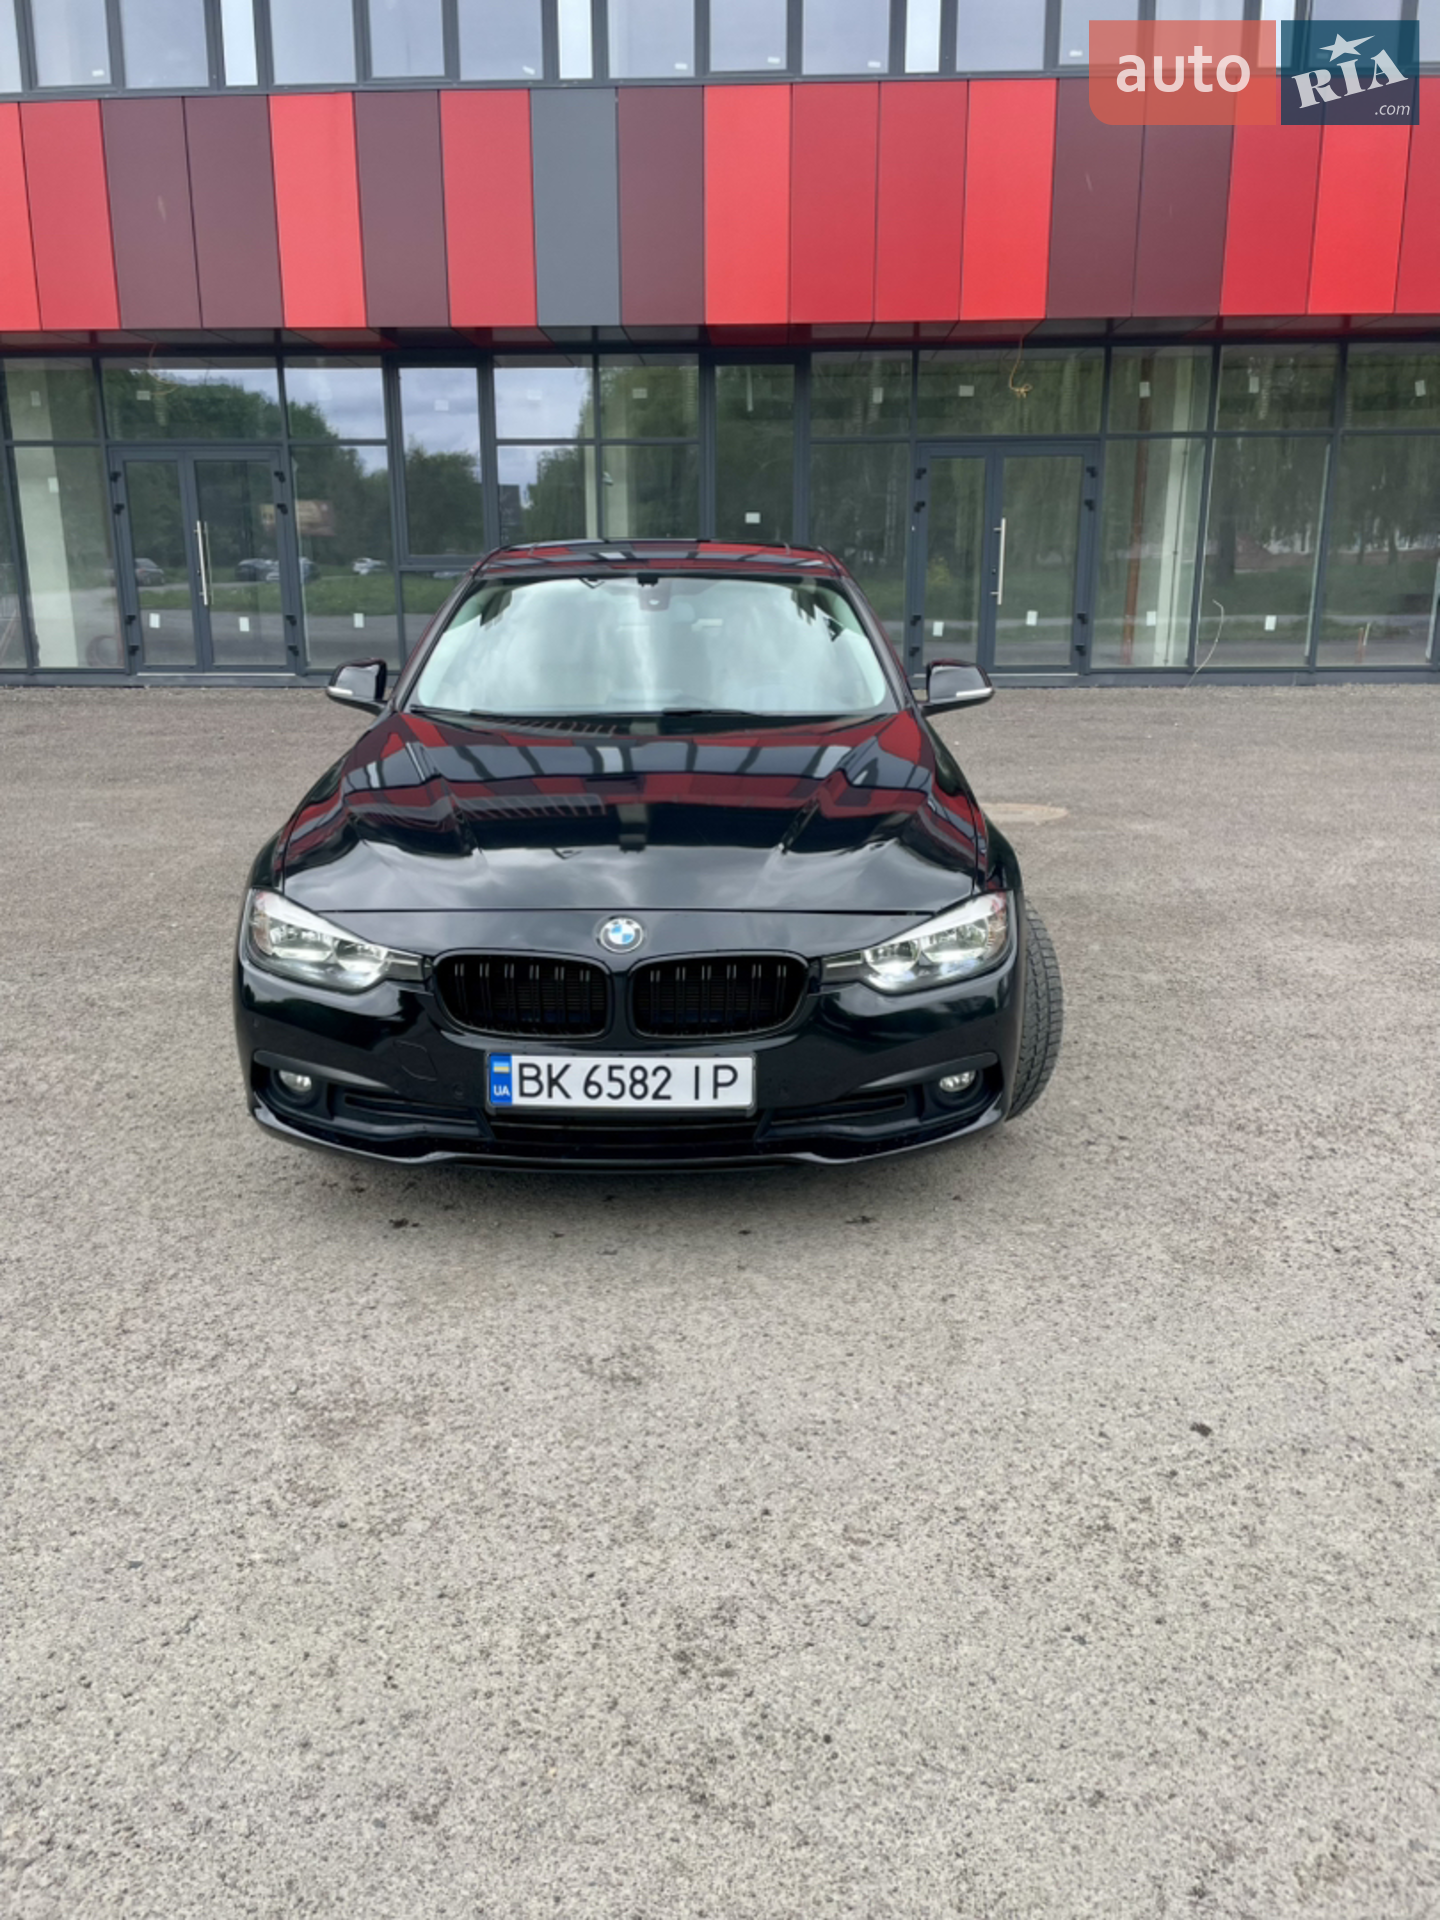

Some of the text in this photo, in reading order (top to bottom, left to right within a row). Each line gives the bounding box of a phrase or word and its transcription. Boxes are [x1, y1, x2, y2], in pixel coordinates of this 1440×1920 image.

[493, 1085, 511, 1096] UA
[518, 1063, 738, 1100] BK 6582 IP
